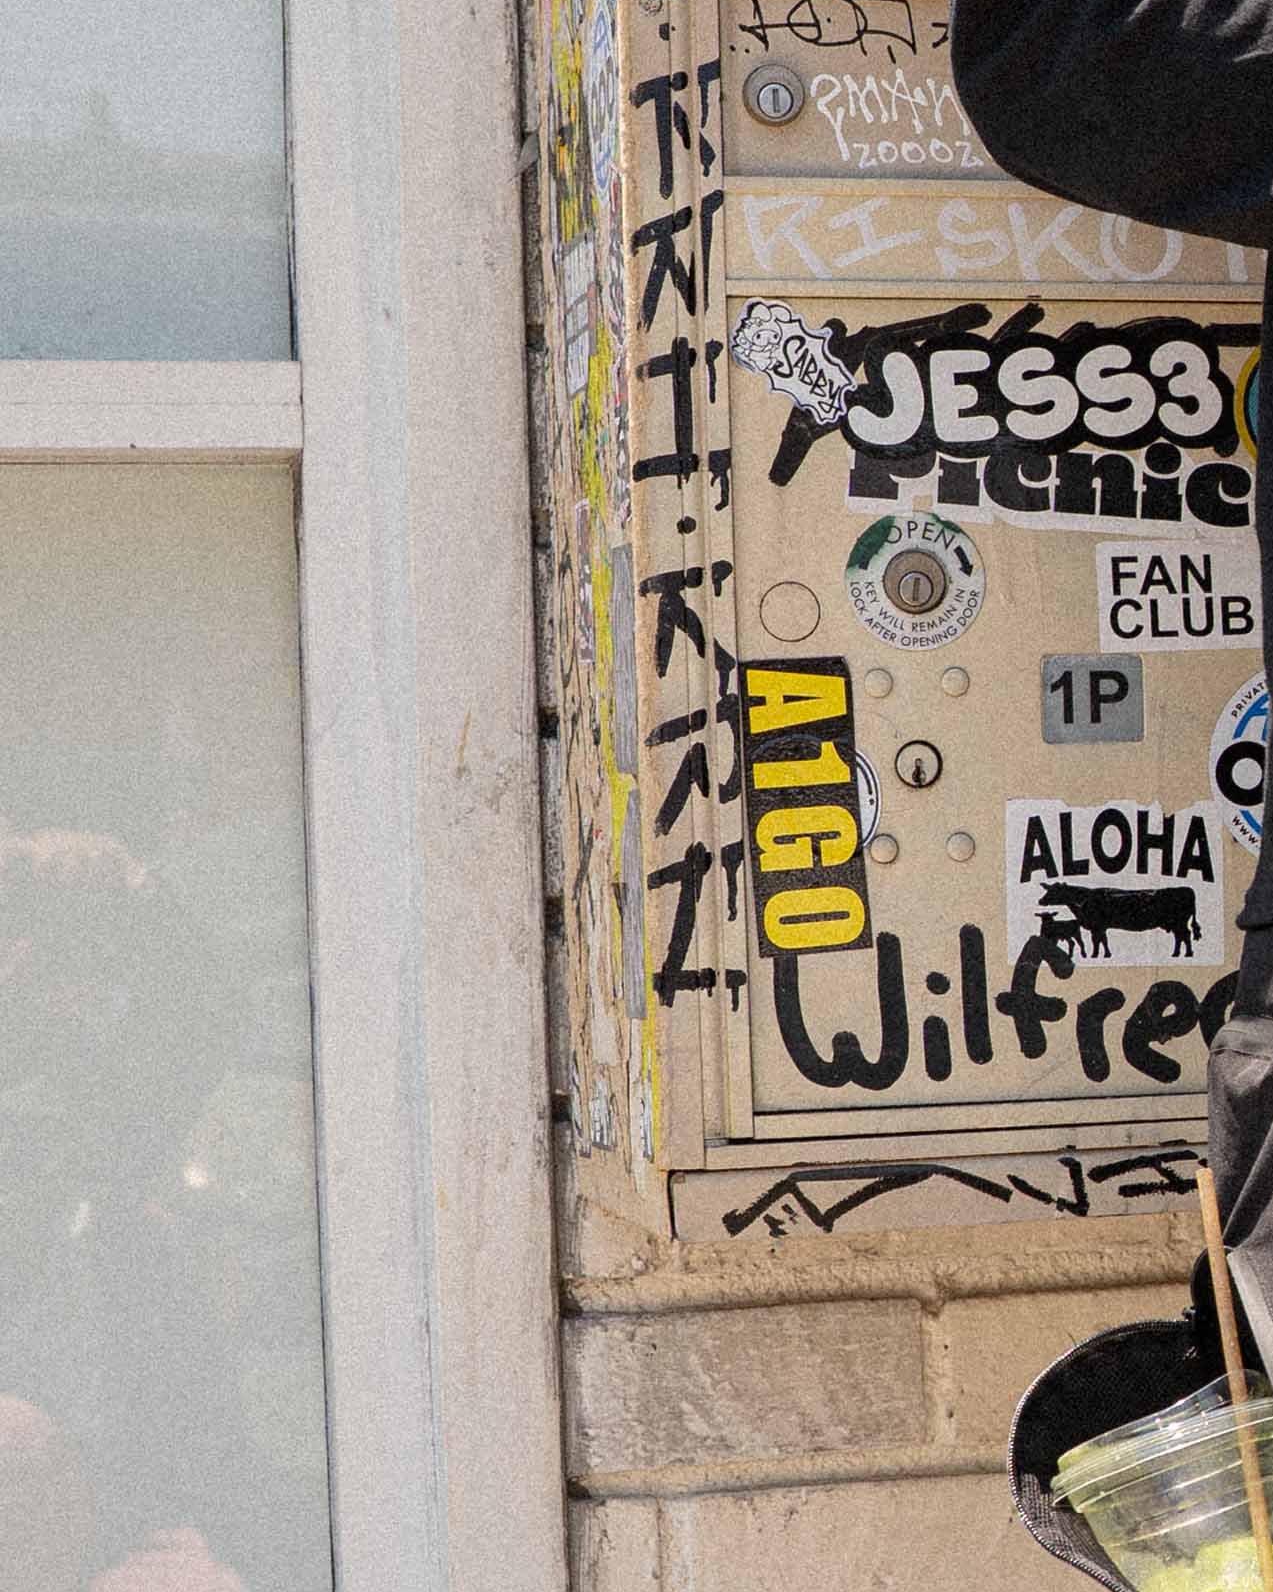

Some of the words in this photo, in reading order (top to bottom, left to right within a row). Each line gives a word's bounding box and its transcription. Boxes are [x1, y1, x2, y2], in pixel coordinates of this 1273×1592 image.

[772, 334, 844, 414] SABBY
[847, 340, 1224, 446] JESS3
[886, 520, 956, 550] OPEN
[1111, 553, 1213, 596] FAN
[850, 581, 869, 615] LOCK
[864, 617, 898, 642] AFTER
[900, 625, 958, 647] OPENING
[956, 589, 981, 627] DOOR
[864, 581, 881, 604] KEY
[879, 606, 905, 631] WILL
[911, 604, 958, 632] REMAIN
[954, 588, 966, 603] IN
[1109, 595, 1254, 639] CLUB
[1050, 669, 1130, 725] 1P
[1231, 681, 1265, 718] PRIVAT
[1020, 809, 1215, 884] ALOHA
